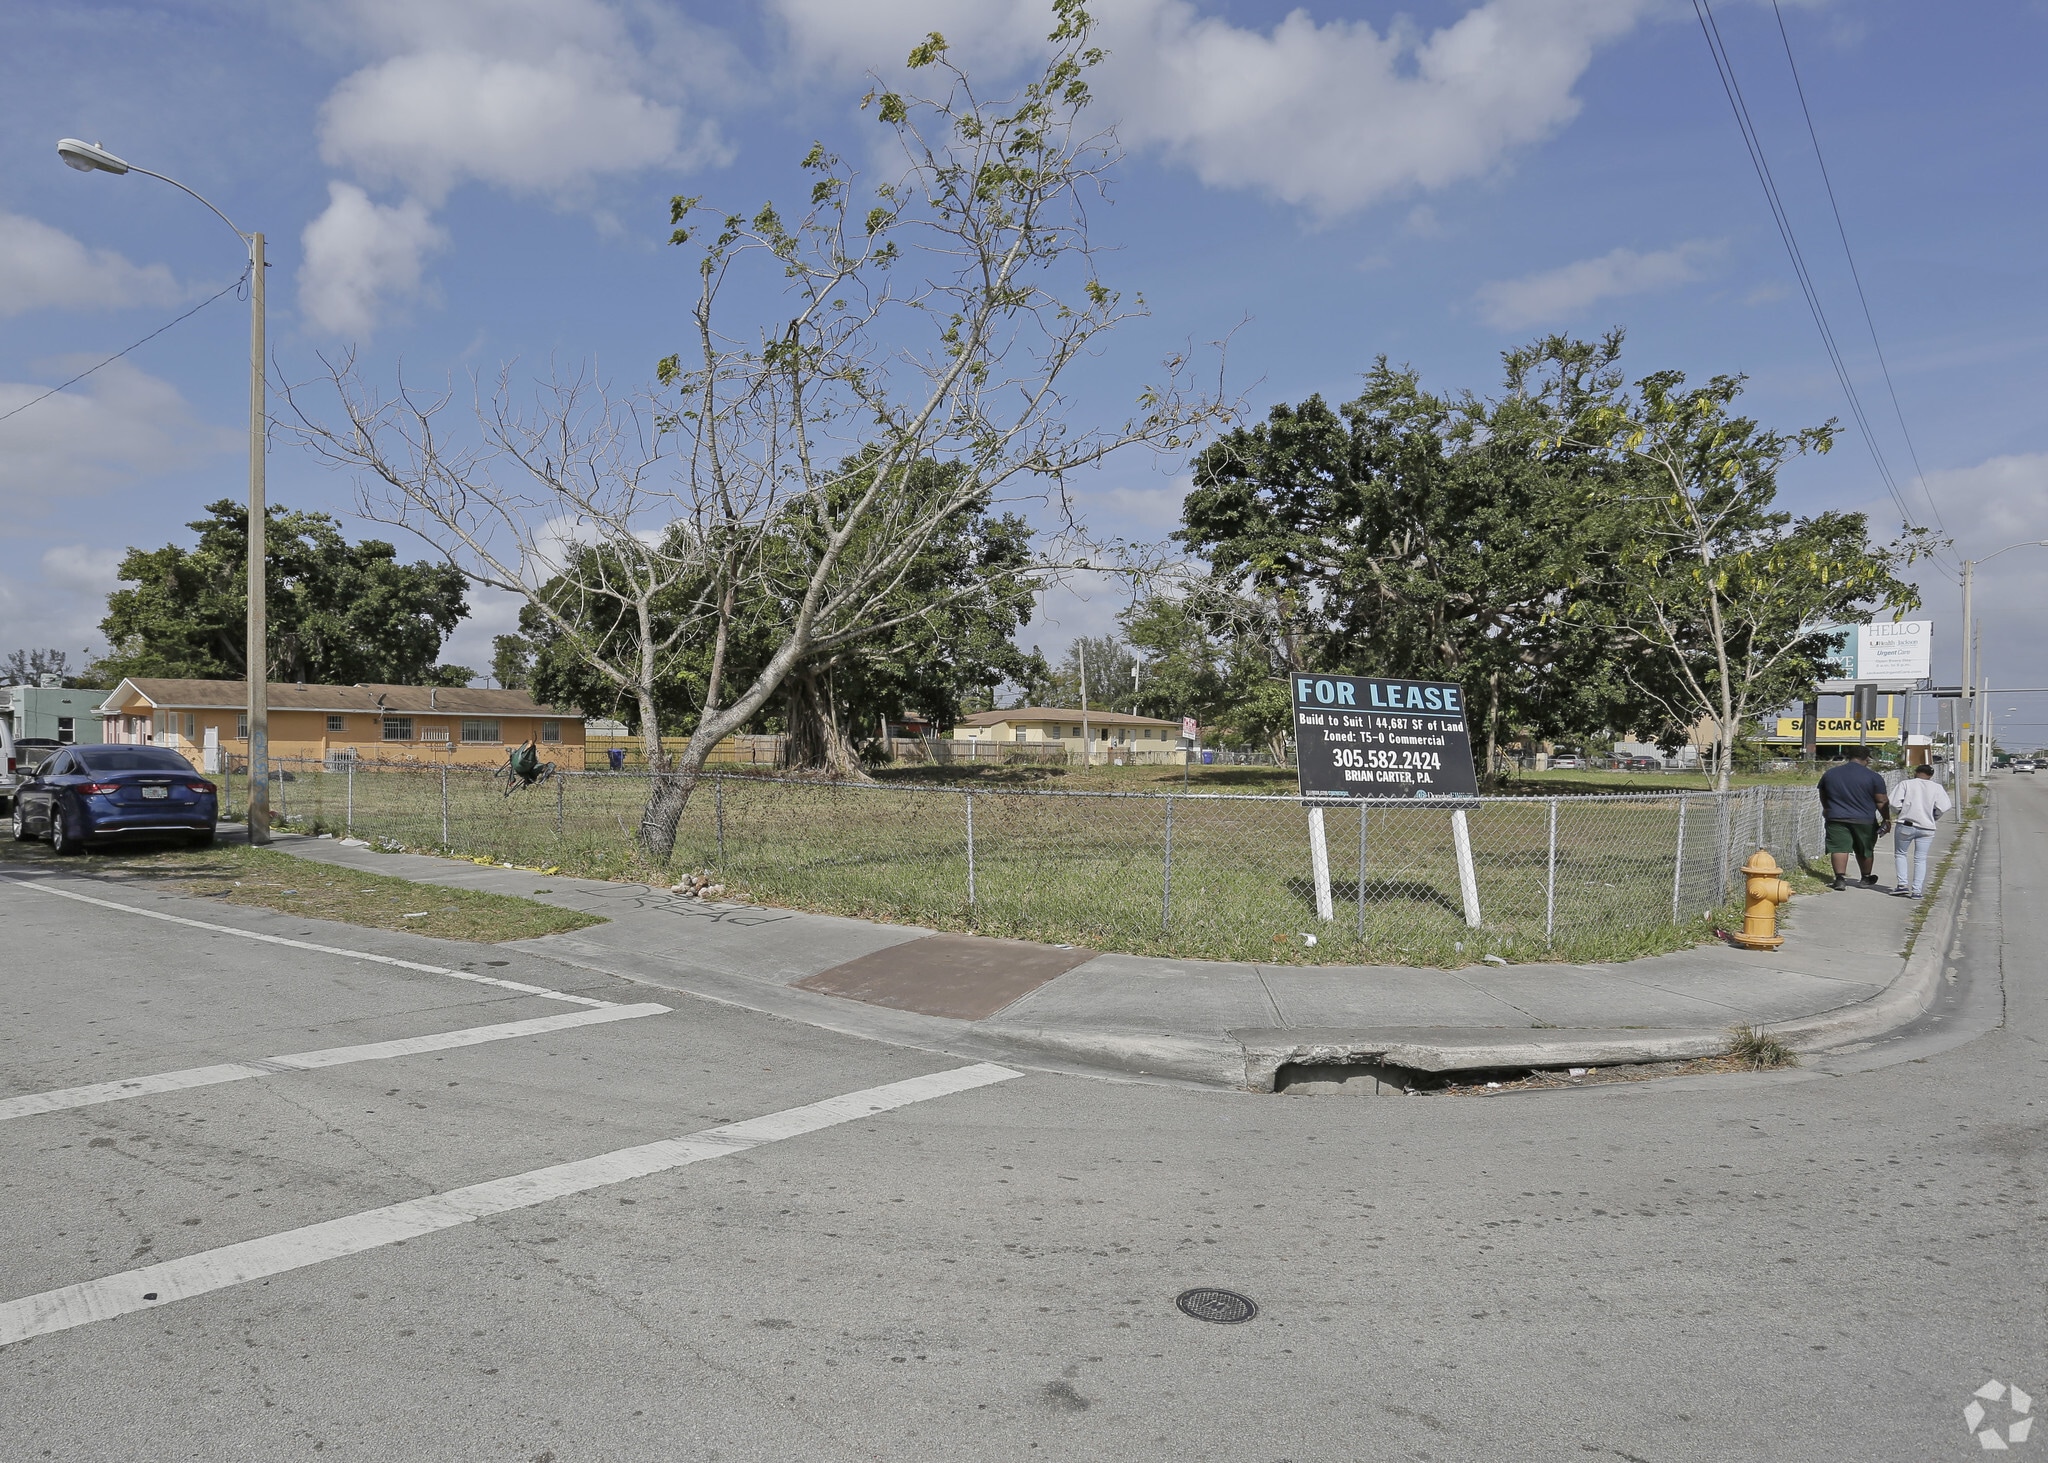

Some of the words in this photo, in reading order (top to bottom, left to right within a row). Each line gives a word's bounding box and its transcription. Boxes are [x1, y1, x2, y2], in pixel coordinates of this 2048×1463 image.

[1869, 623, 1920, 636] HELLO
[1297, 679, 1356, 705] FOR
[1369, 683, 1460, 711] LEASE
[1299, 713, 1324, 726] Build
[1328, 715, 1339, 727] to
[1343, 715, 1363, 728] Suit
[1375, 717, 1408, 730] 44,687
[1412, 719, 1423, 731] SF
[1428, 720, 1437, 731] of
[1441, 721, 1464, 732] Land
[1828, 720, 1851, 731] CAR
[1323, 729, 1357, 743] Zoned:
[1389, 733, 1445, 746] Commercial
[1332, 748, 1441, 770] 305.582.2424
[1345, 770, 1374, 782] BRIAN
[1376, 771, 1415, 785] CARTER,
[1417, 772, 1434, 784] P.A.
